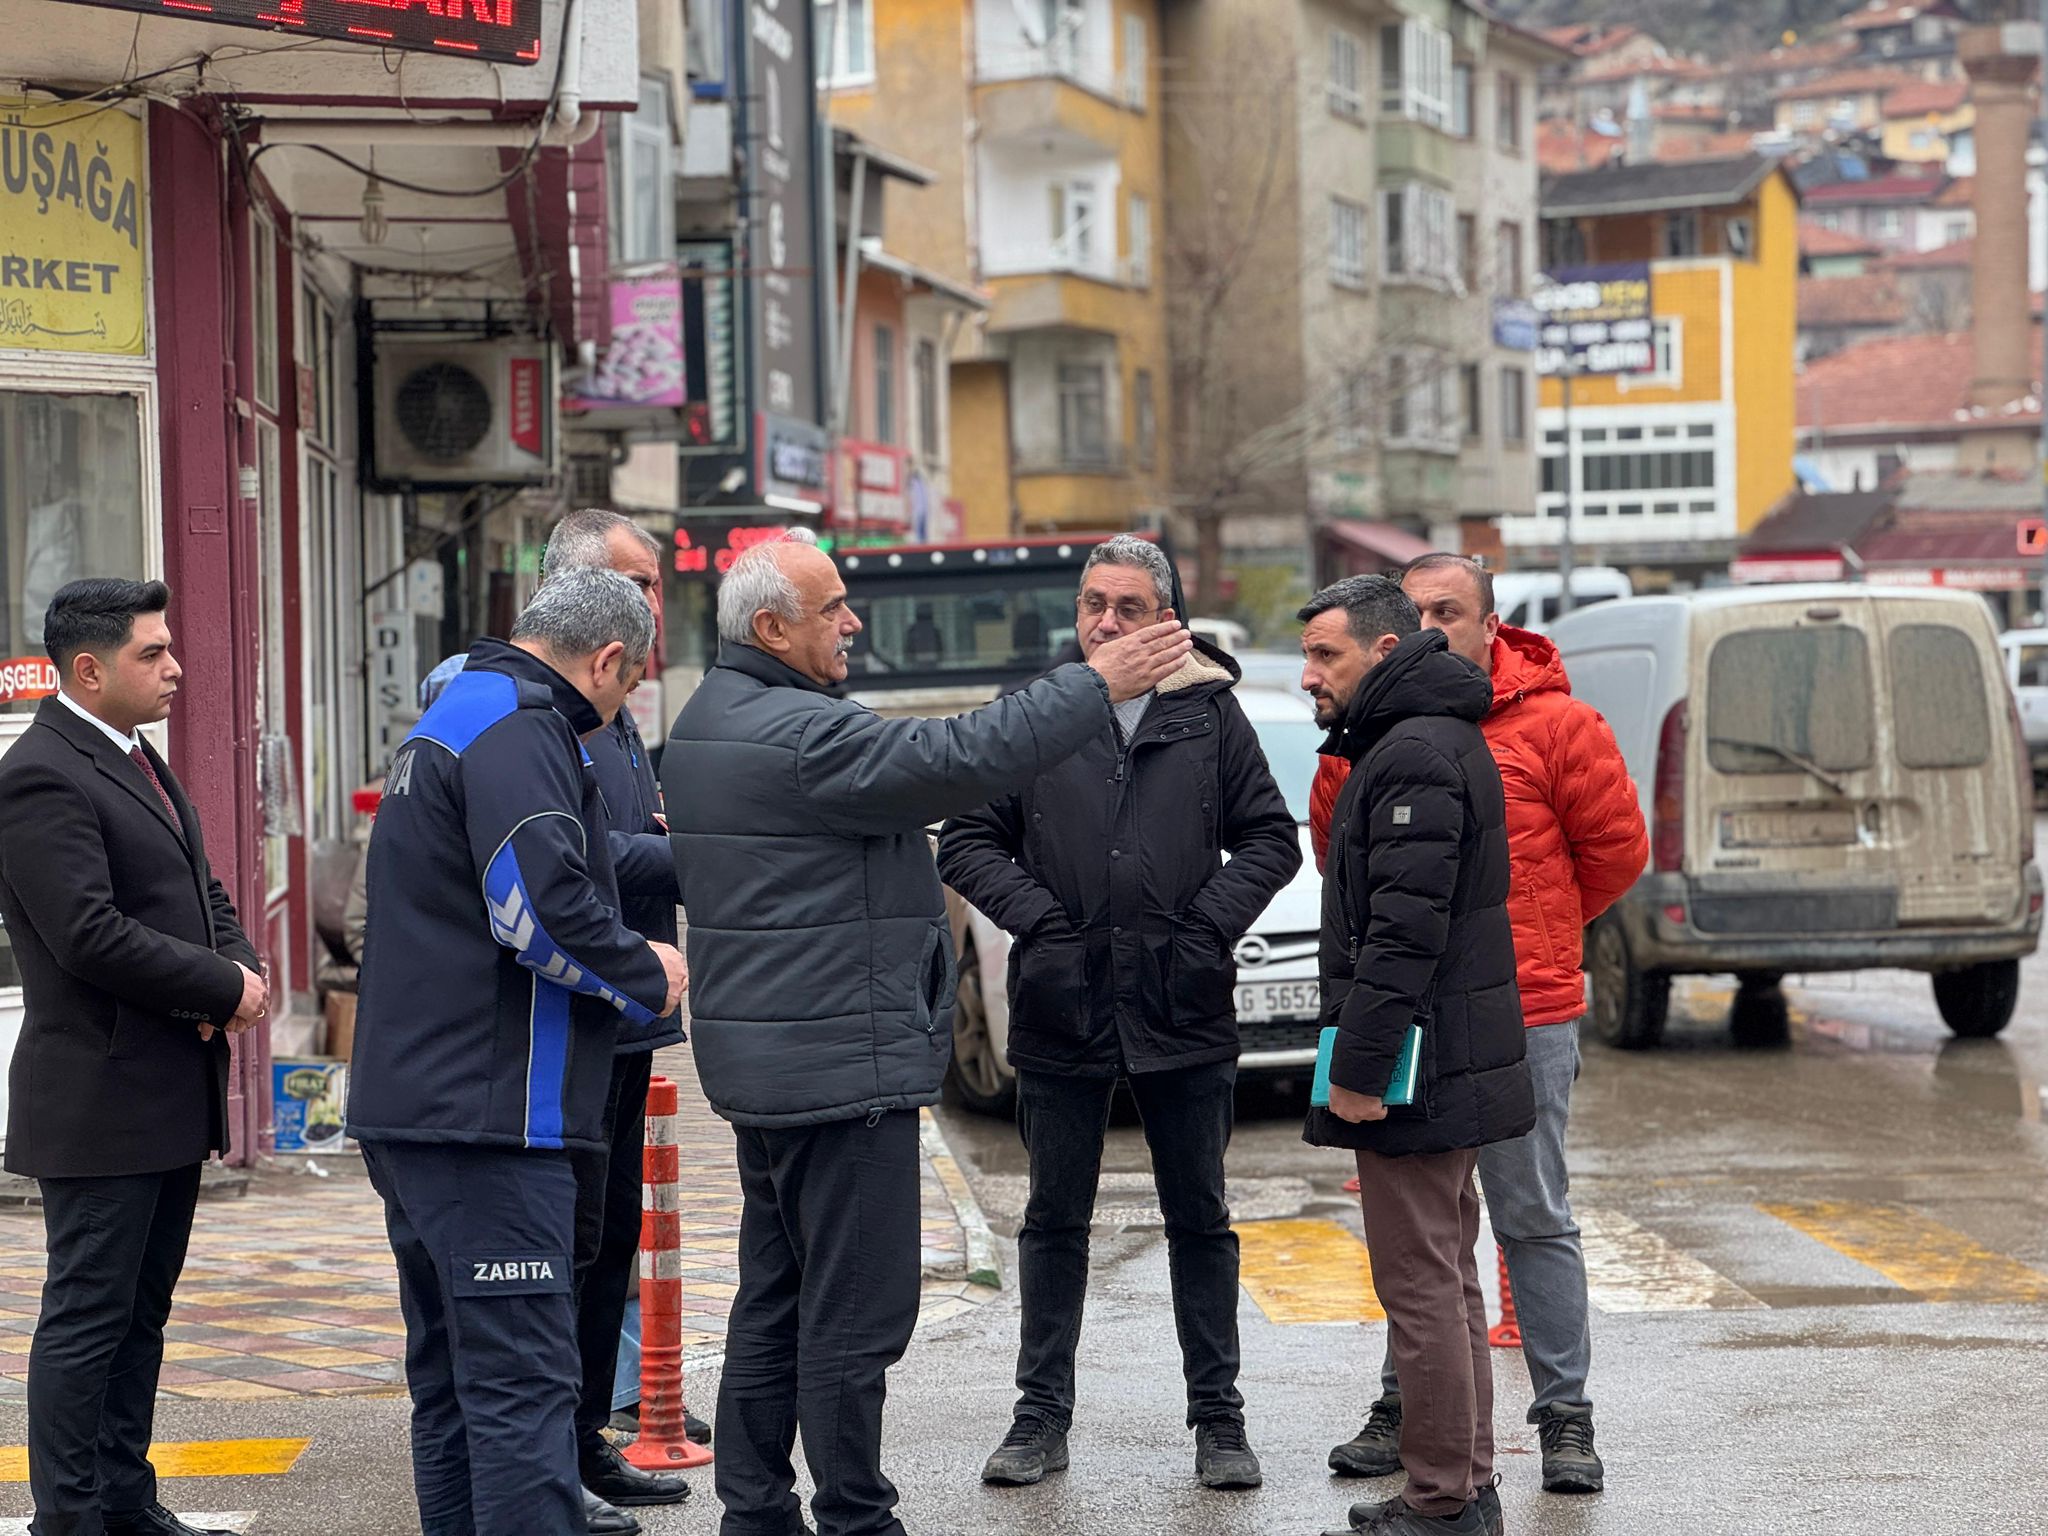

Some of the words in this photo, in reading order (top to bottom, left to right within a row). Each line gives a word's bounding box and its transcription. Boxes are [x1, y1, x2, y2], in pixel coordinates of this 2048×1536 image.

[1, 255, 120, 294] RKET
[1265, 985, 1320, 1011] 5652
[473, 1262, 554, 1281] ZABITA
